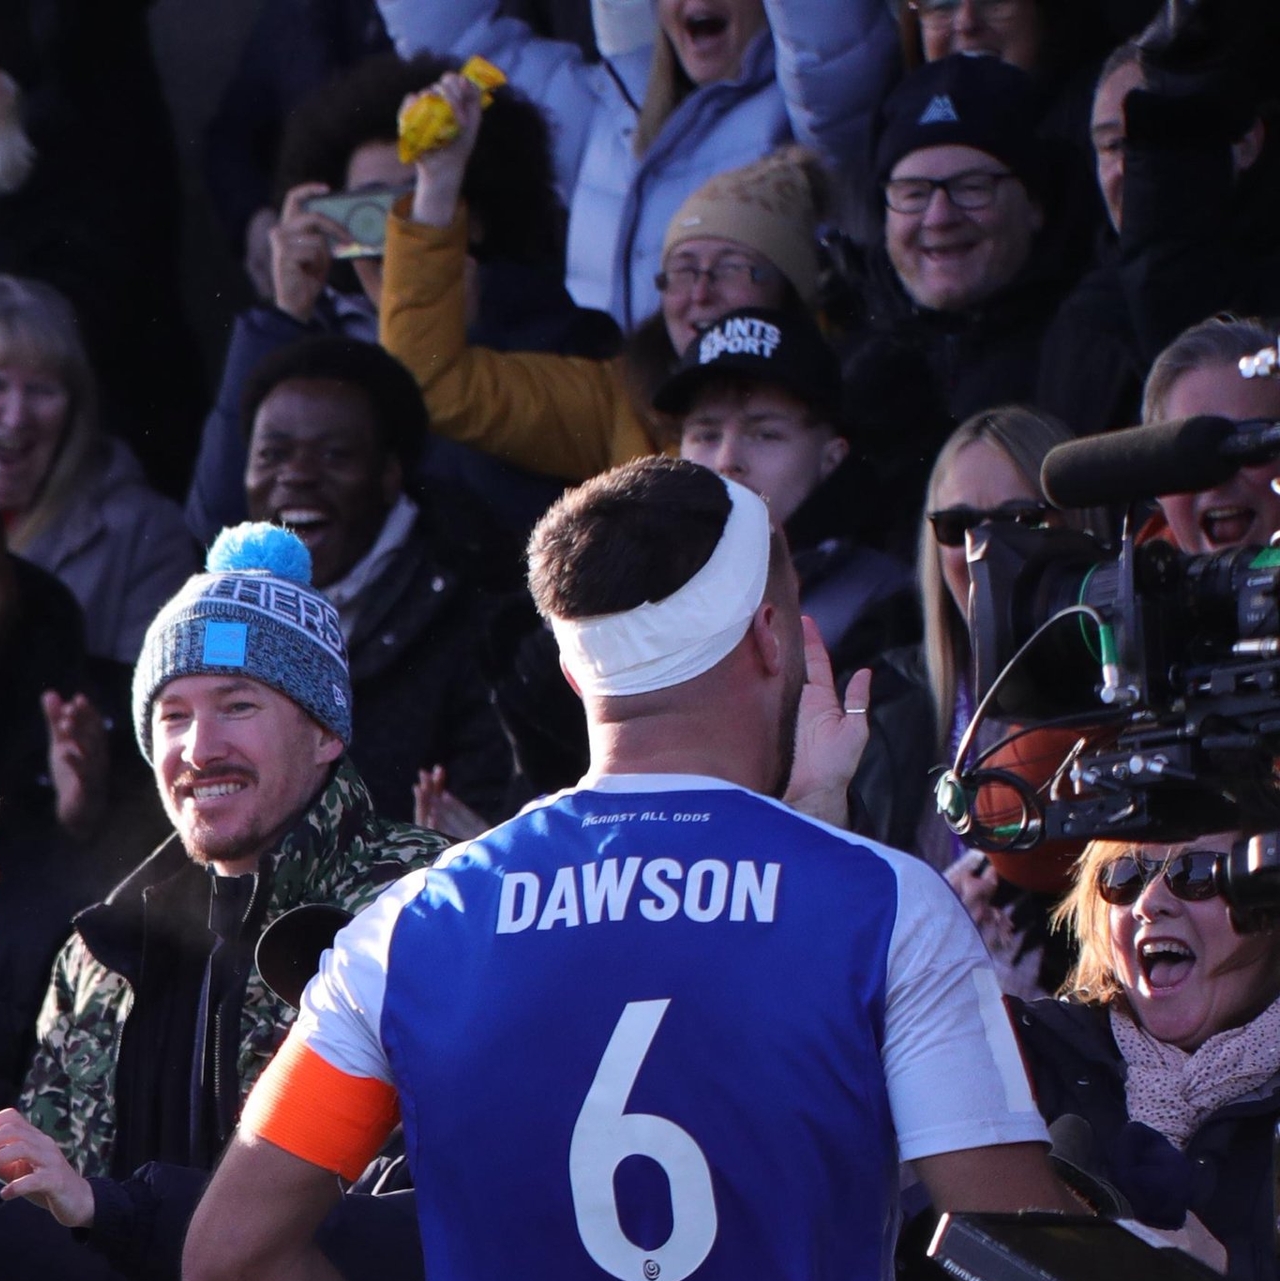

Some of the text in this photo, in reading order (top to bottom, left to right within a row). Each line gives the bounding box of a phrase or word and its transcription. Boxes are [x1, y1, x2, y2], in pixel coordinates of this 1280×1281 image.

[581, 811, 711, 828] AGAINST ALL ODDS
[496, 856, 781, 934] DAWSON
